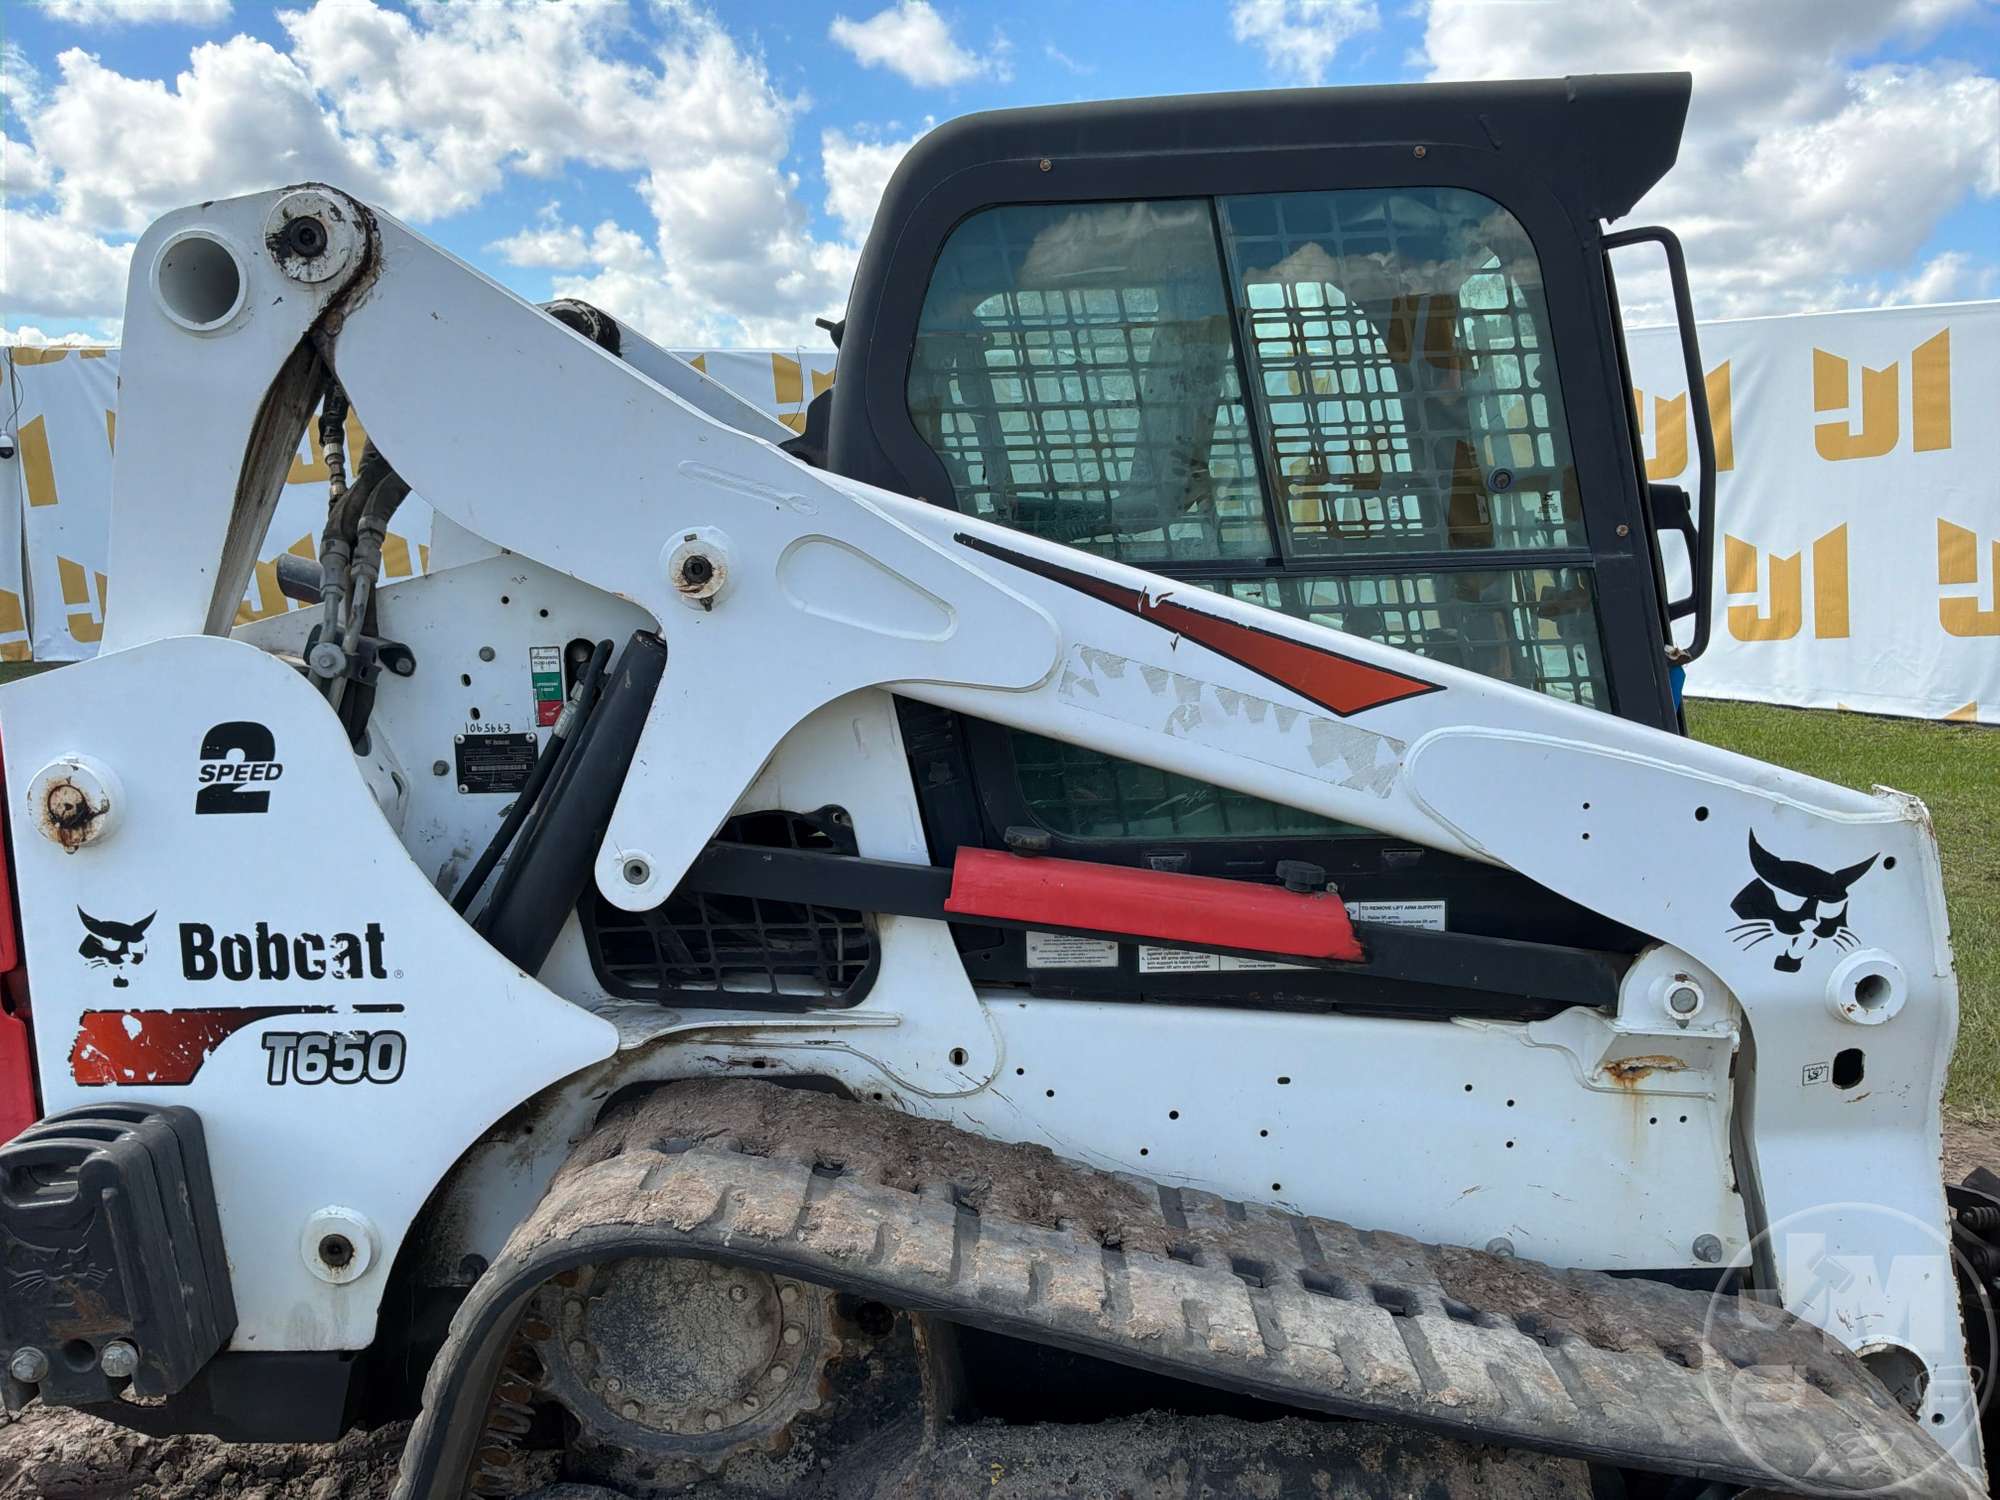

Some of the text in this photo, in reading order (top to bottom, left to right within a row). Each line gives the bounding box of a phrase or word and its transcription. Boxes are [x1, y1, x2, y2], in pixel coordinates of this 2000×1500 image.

[195, 721, 276, 814] 2
[198, 761, 283, 783] SPEED
[179, 922, 386, 981] Bobcat
[261, 1030, 406, 1085] T650
